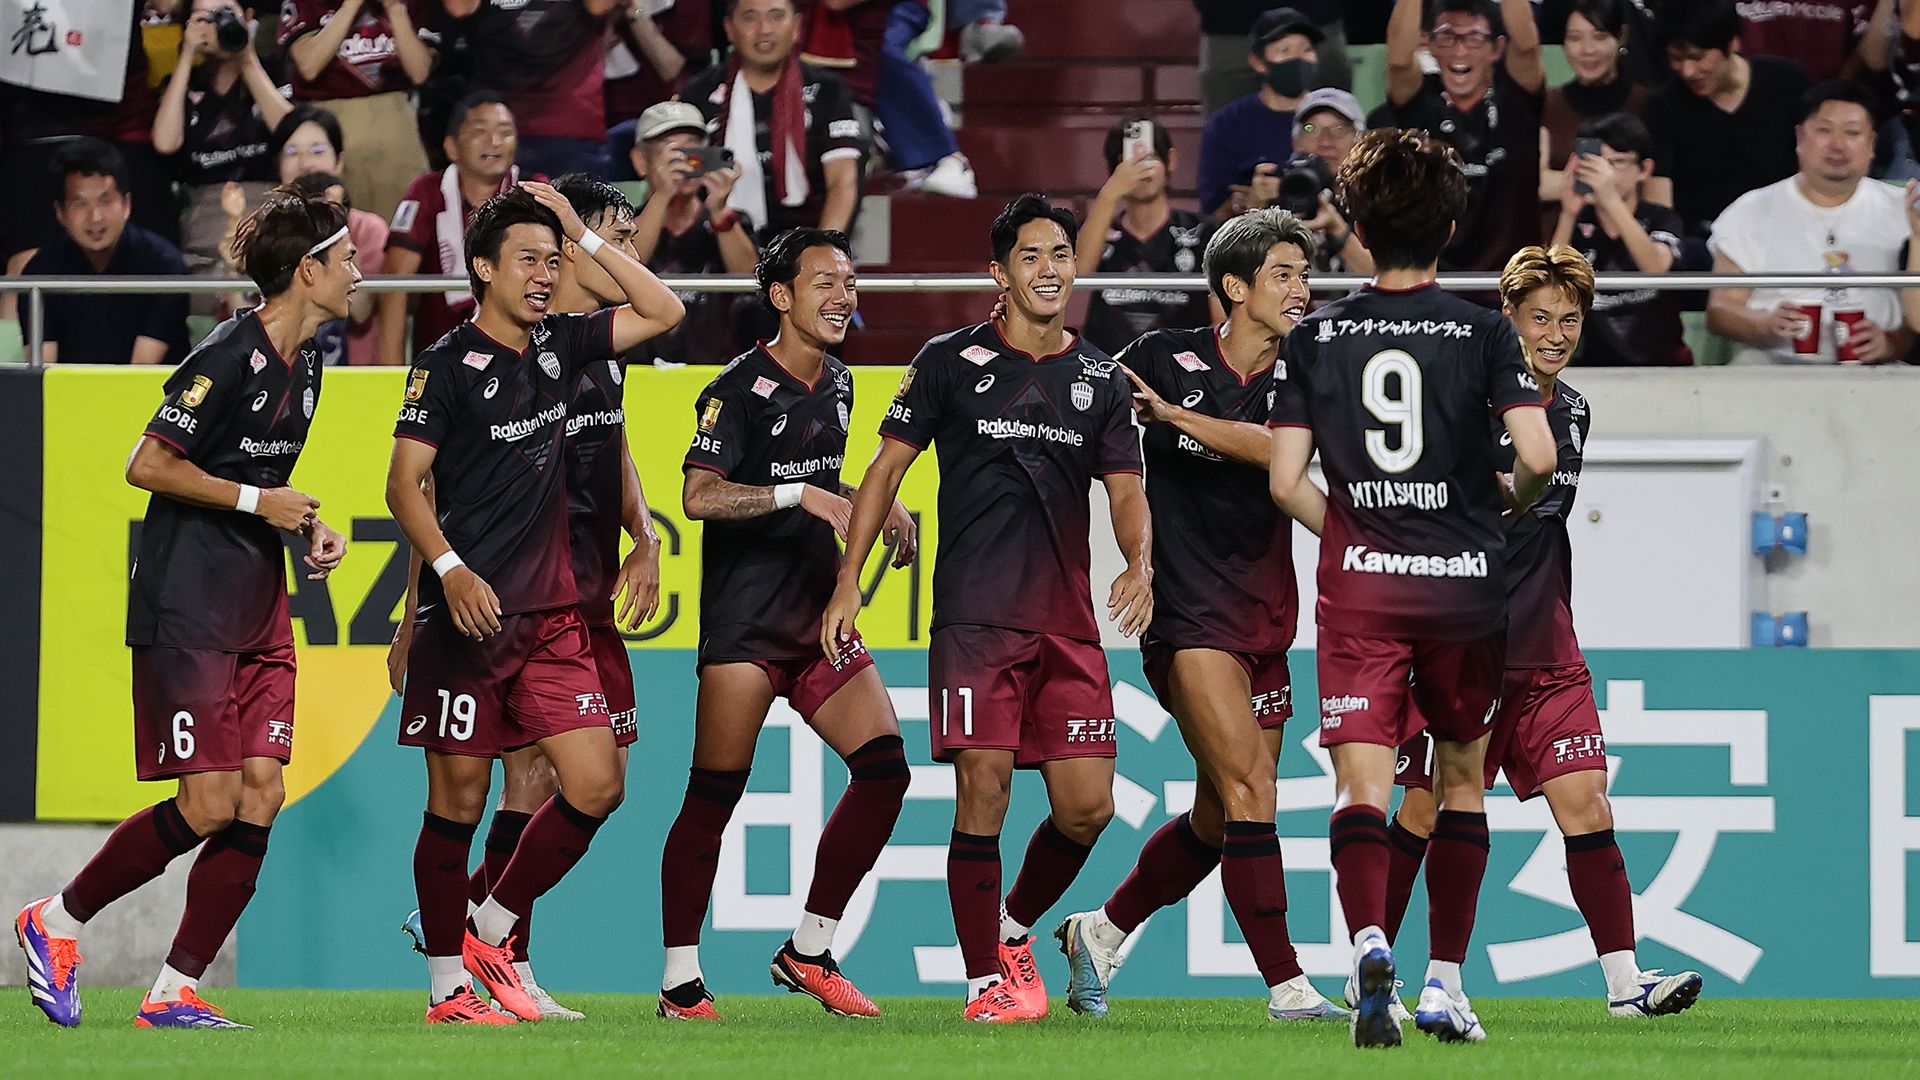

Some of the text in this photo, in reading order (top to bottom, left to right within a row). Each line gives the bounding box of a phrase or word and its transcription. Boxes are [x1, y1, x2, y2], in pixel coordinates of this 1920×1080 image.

[158, 404, 199, 435] KOBE
[398, 407, 429, 425] OBE
[886, 402, 912, 424] OBE
[1362, 348, 1423, 475] 9
[977, 417, 1084, 447] Rakuten Mobile
[770, 459, 821, 480] Rakuten
[1347, 480, 1449, 510] MIYASHIRO
[1342, 545, 1489, 578] Kawasaki
[437, 688, 477, 741] 19
[942, 687, 973, 736] 11
[172, 710, 195, 759] 6
